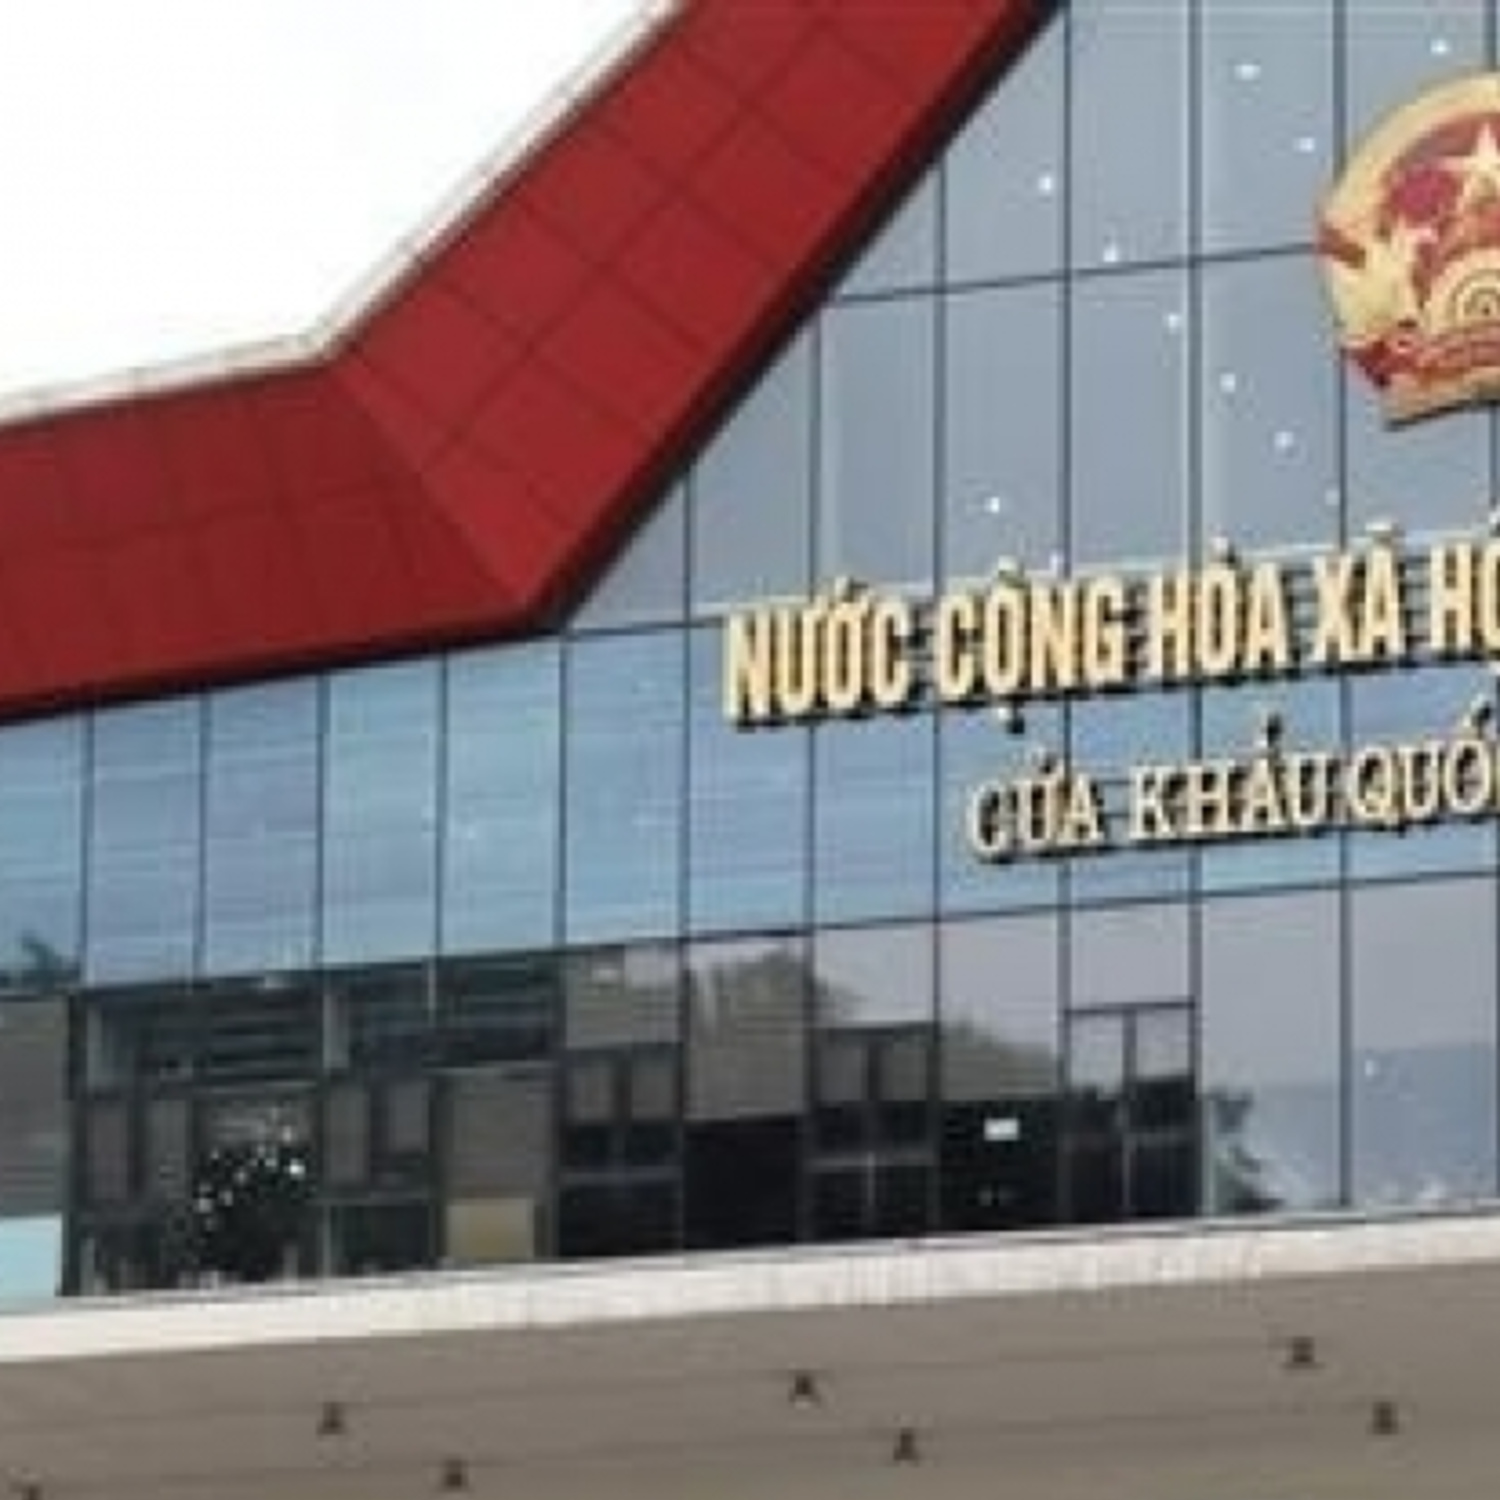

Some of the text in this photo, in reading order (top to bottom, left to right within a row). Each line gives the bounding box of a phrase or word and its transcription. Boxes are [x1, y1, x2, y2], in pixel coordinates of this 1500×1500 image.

[725, 575, 912, 722] NƯỚC
[937, 556, 1127, 722] CỘNG
[1148, 535, 1290, 680] HÒA
[1311, 521, 1404, 664] XÃ
[968, 747, 1104, 858] CỬA
[1130, 711, 1328, 842] KHẨU
